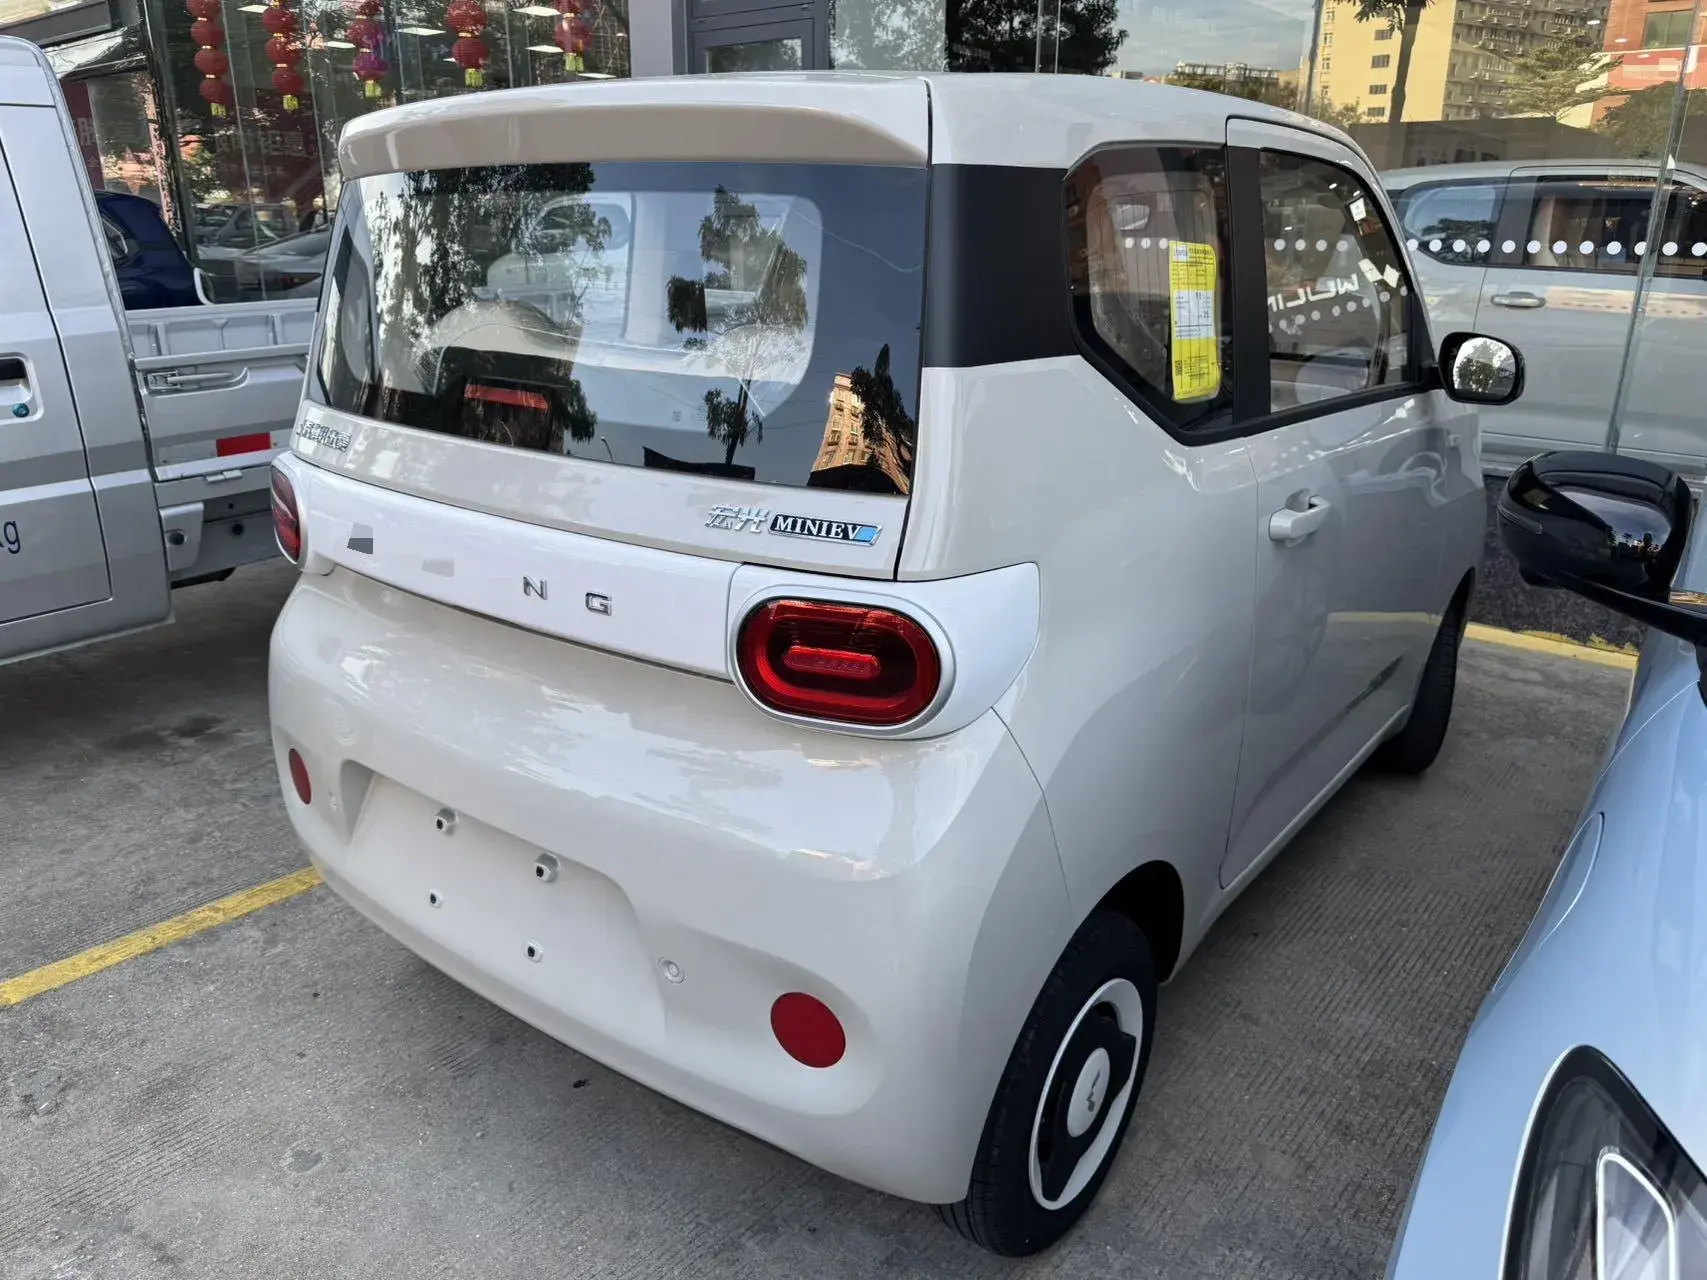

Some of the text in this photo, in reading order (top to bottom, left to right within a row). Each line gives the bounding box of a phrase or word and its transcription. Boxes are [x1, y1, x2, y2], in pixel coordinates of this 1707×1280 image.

[0, 520, 20, 554] g
[704, 504, 863, 541] 宏光 MINIEV
